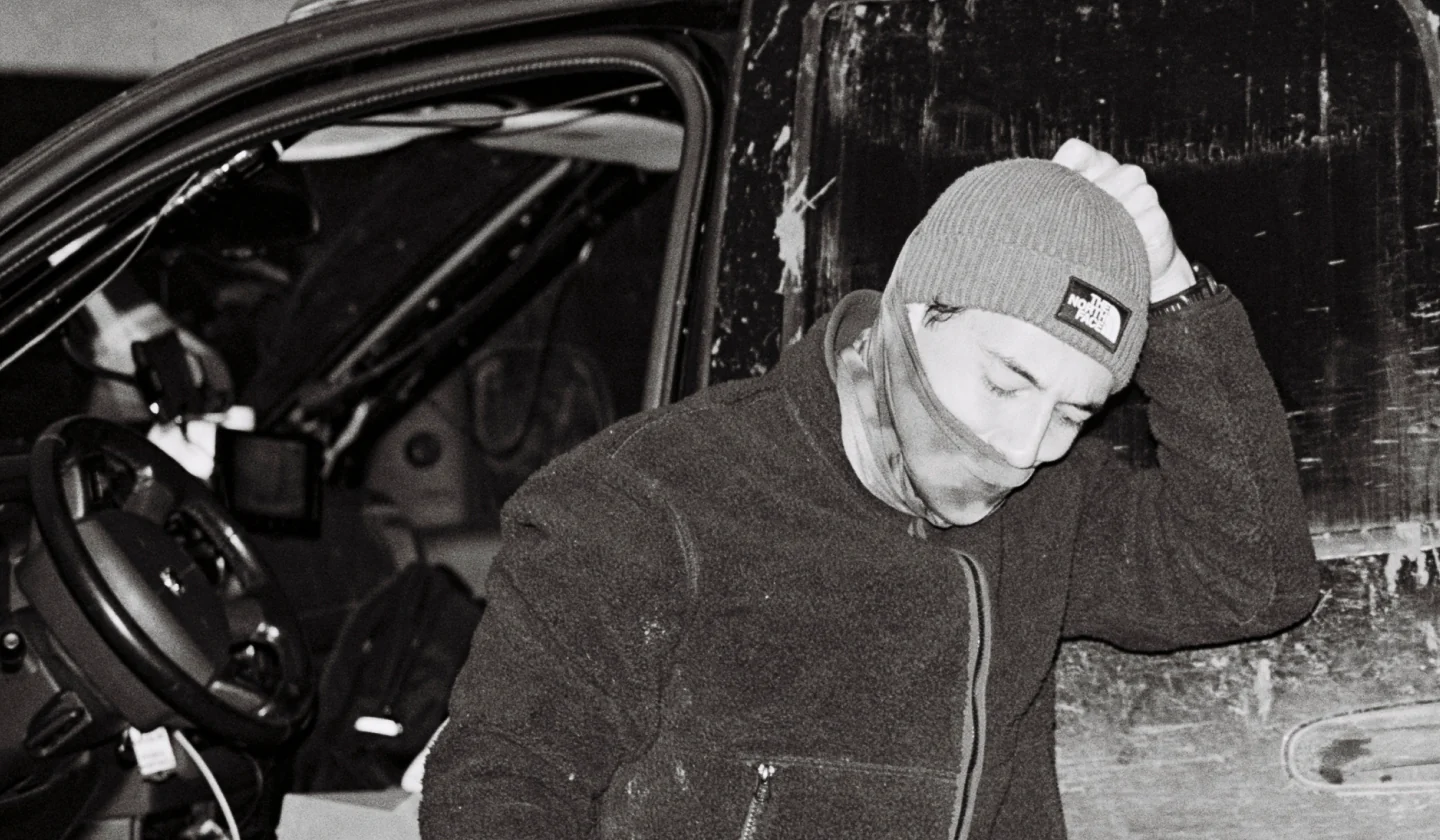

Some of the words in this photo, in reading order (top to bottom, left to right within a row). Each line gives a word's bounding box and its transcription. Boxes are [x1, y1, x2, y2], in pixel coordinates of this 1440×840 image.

[1067, 294, 1109, 323] NORTH
[1088, 293, 1111, 313] THE
[1075, 308, 1105, 333] FACE
